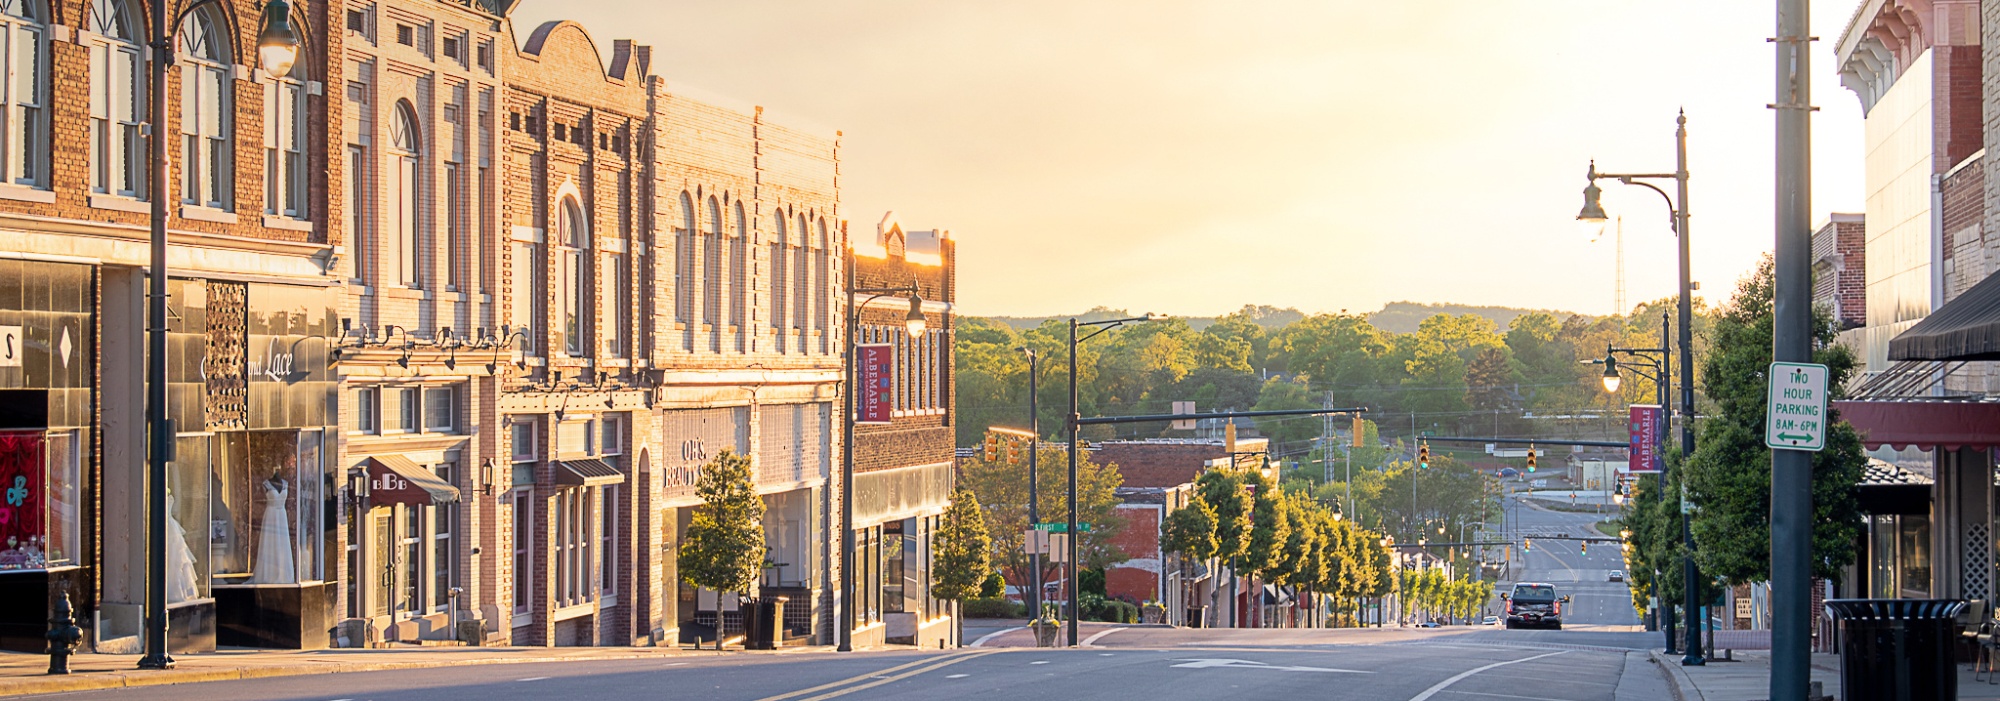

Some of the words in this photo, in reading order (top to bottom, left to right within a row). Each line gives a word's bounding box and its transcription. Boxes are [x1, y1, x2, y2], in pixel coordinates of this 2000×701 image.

[5, 333, 15, 360] S
[265, 334, 293, 383] Lace
[868, 349, 878, 419] ALBEMARLE
[1790, 372, 1809, 384] TWO
[1783, 388, 1812, 400] HOUR
[1775, 403, 1819, 416] PARKING
[1641, 410, 1650, 469] ALBEMARLE
